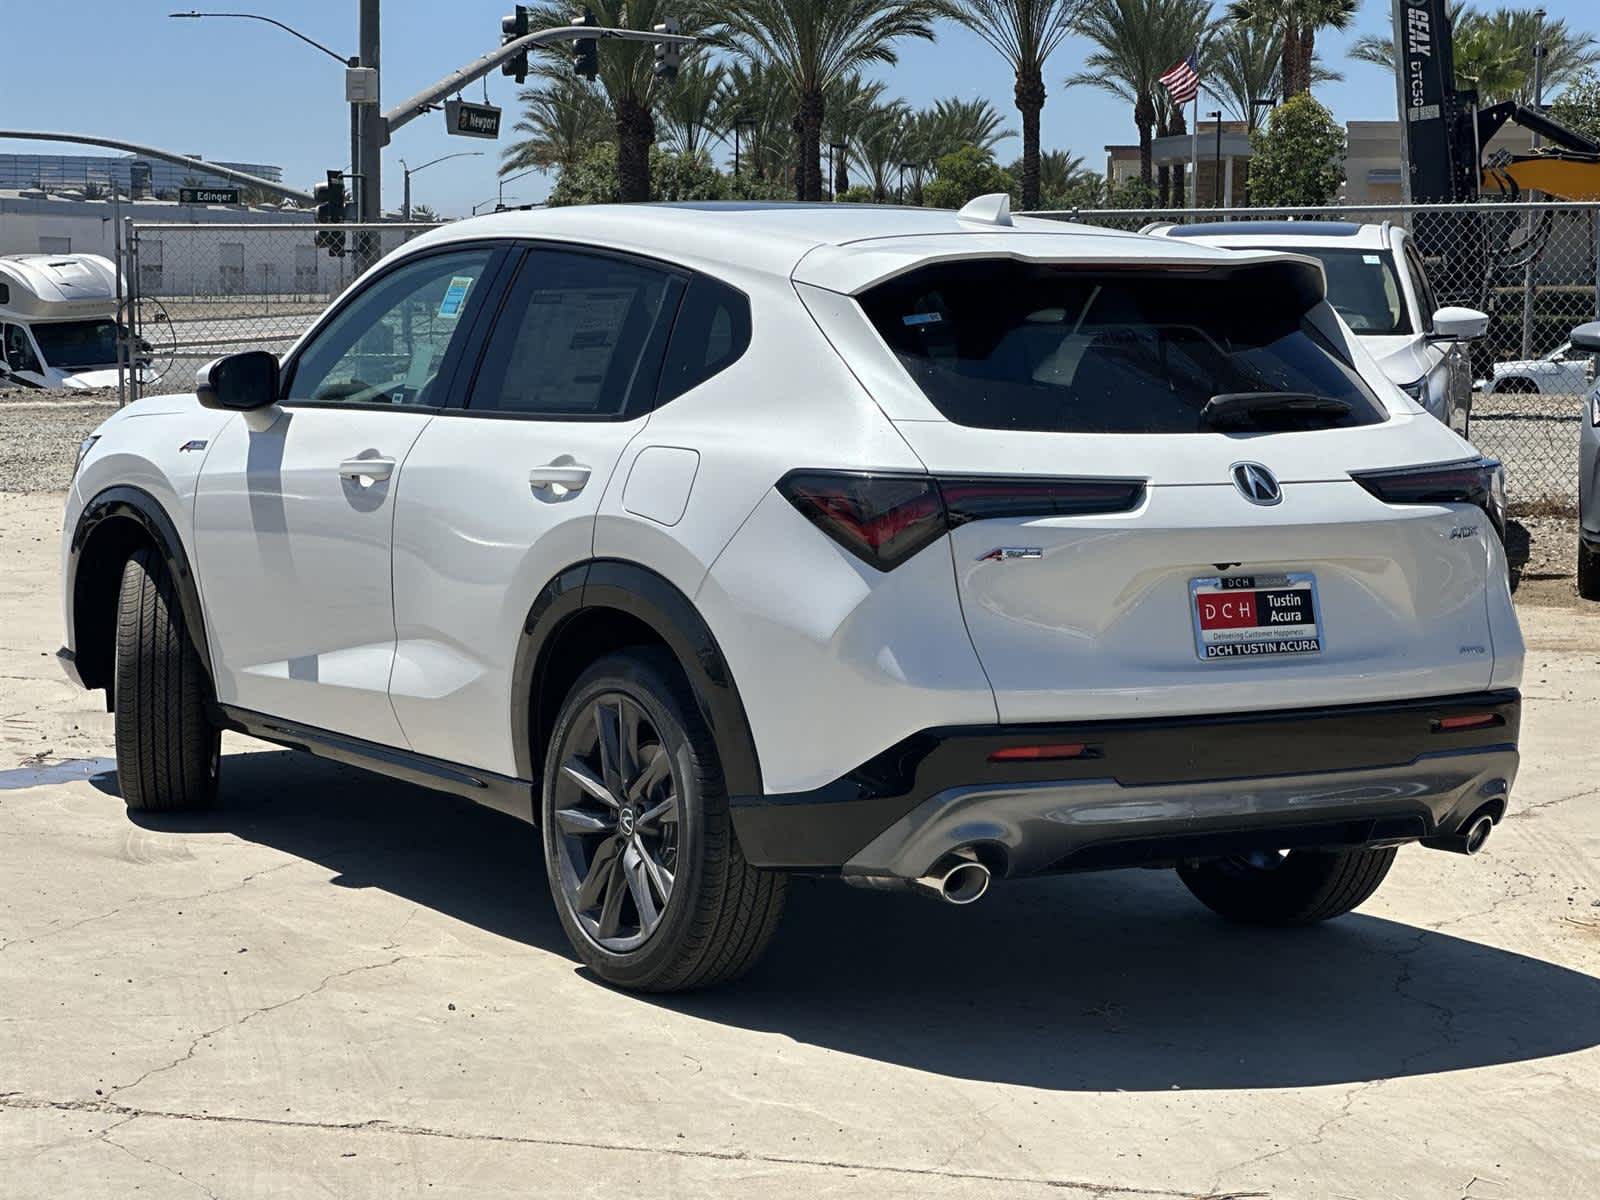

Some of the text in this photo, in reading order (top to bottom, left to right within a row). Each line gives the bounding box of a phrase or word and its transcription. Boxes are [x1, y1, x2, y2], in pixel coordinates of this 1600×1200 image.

[1407, 8, 1431, 57] GEAX
[1410, 61, 1424, 106] DTC50
[470, 112, 497, 132] Newport
[197, 191, 232, 203] Edinger
[1227, 578, 1250, 588] DCH
[1266, 593, 1302, 608] Tustin
[1270, 610, 1302, 623] Acura
[1213, 631, 1243, 641] Delivering
[1244, 630, 1273, 639] Customer
[1208, 639, 1319, 657] DCH TUSTIN ACURA
